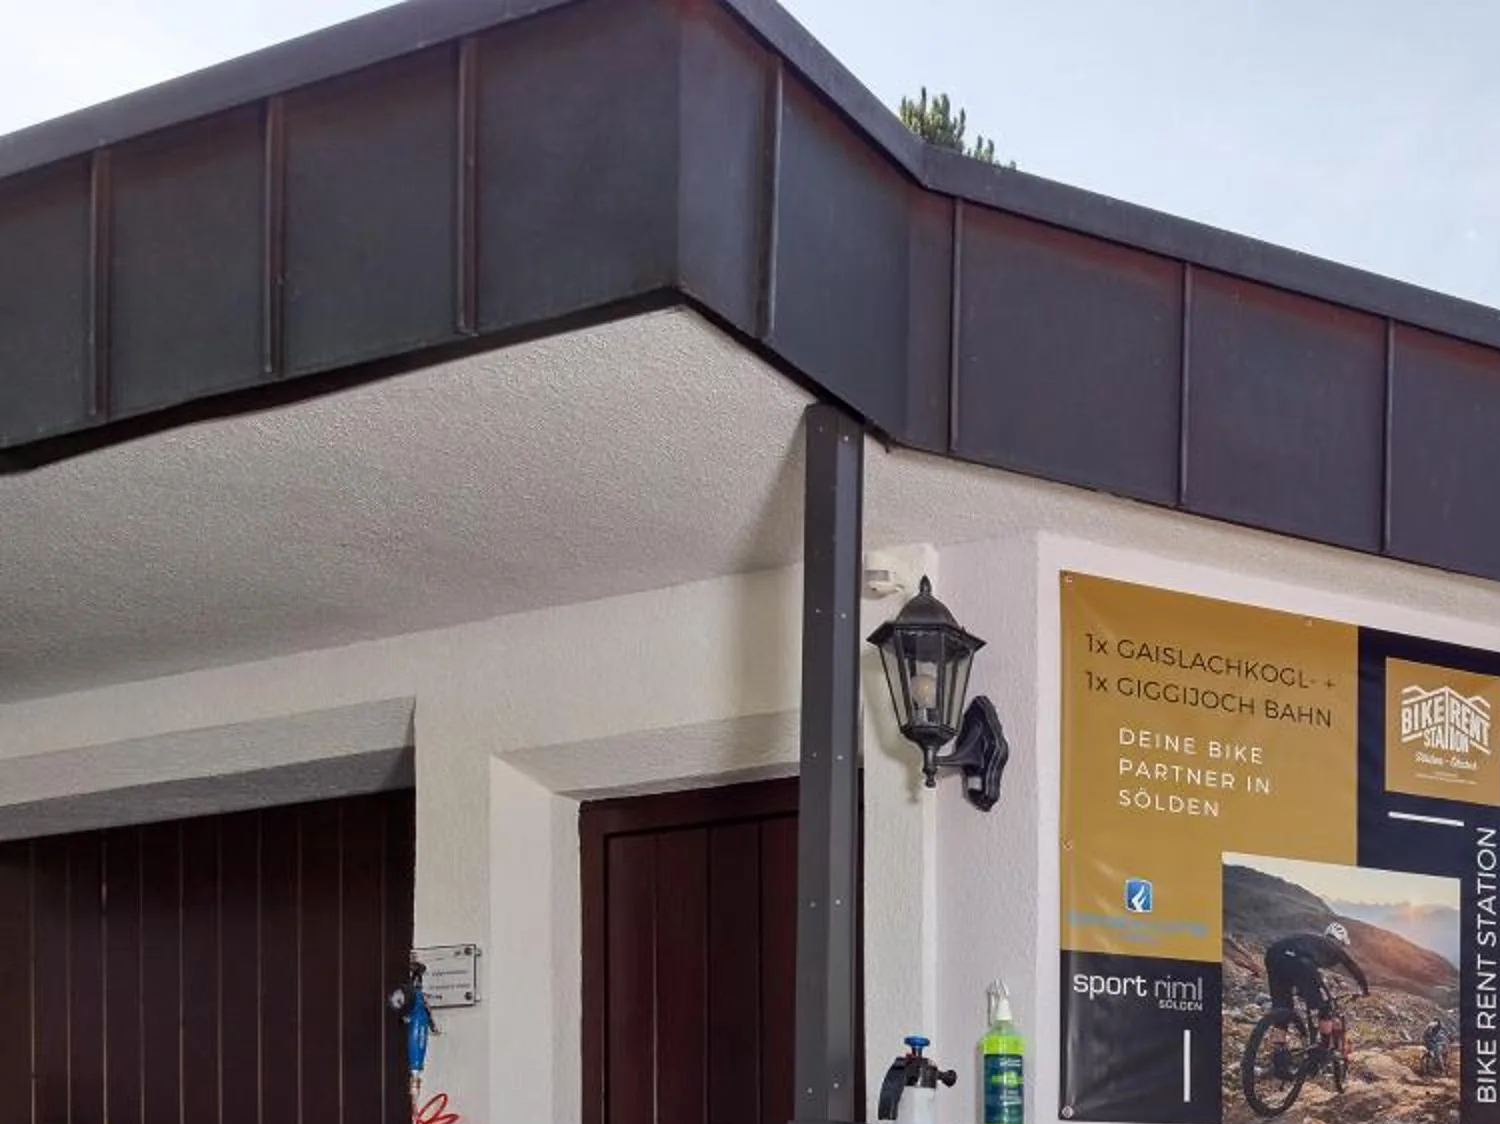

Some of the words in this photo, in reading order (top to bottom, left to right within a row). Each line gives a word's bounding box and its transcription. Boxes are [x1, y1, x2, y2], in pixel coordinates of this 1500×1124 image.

[1085, 633, 1108, 655] 1x
[1085, 671, 1108, 692] 1x
[1117, 677, 1255, 715] GIGGIJOCH
[1264, 699, 1332, 729] BAHN
[1401, 696, 1444, 736] BIKE
[1450, 698, 1491, 747] RENT
[1423, 725, 1469, 753] STATION
[1119, 727, 1197, 755] DEINE
[1208, 741, 1264, 764] BIKE
[1119, 759, 1236, 790] PARTNER
[1247, 776, 1270, 794] IN
[1119, 787, 1219, 817] SÖLDEN
[1477, 827, 1497, 948] STATION
[1073, 974, 1148, 1001] sport
[1154, 975, 1203, 1001] riml
[1477, 953, 1497, 1029] RENT
[1477, 1039, 1497, 1103] BIKE
